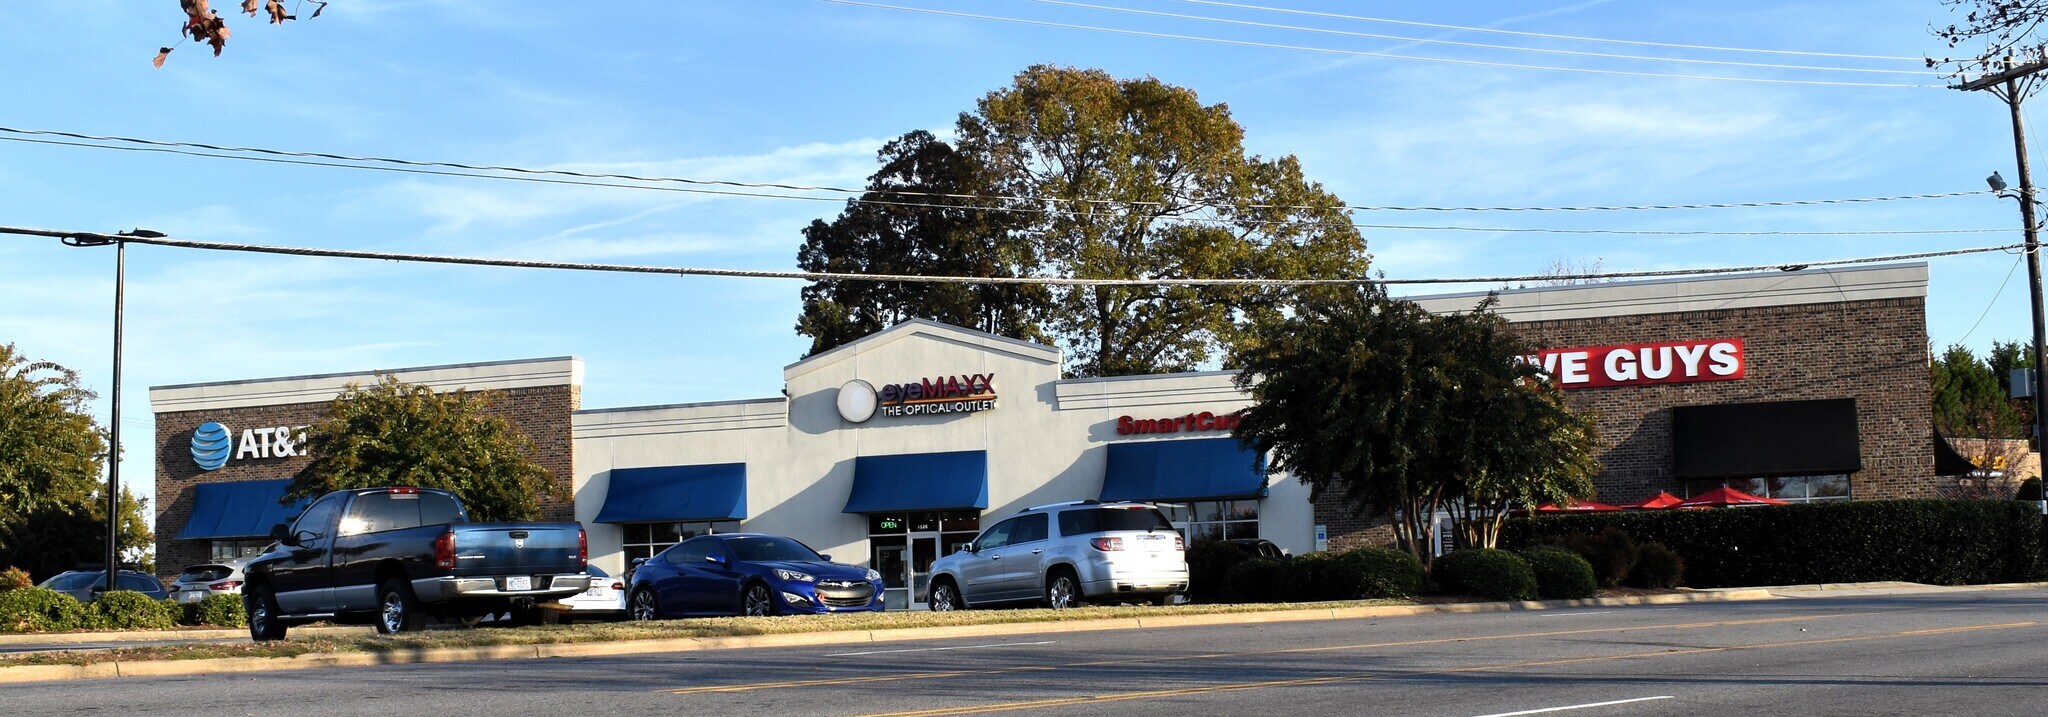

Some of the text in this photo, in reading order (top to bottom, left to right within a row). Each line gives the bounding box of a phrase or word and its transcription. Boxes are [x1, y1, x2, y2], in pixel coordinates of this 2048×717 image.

[1509, 343, 1740, 388] VE GUYS
[881, 373, 996, 404] eyeMAXX
[882, 399, 996, 417] THE OPTICAL OUTLET
[1117, 411, 1244, 435] SmartCut
[881, 521, 897, 529] OPEN
